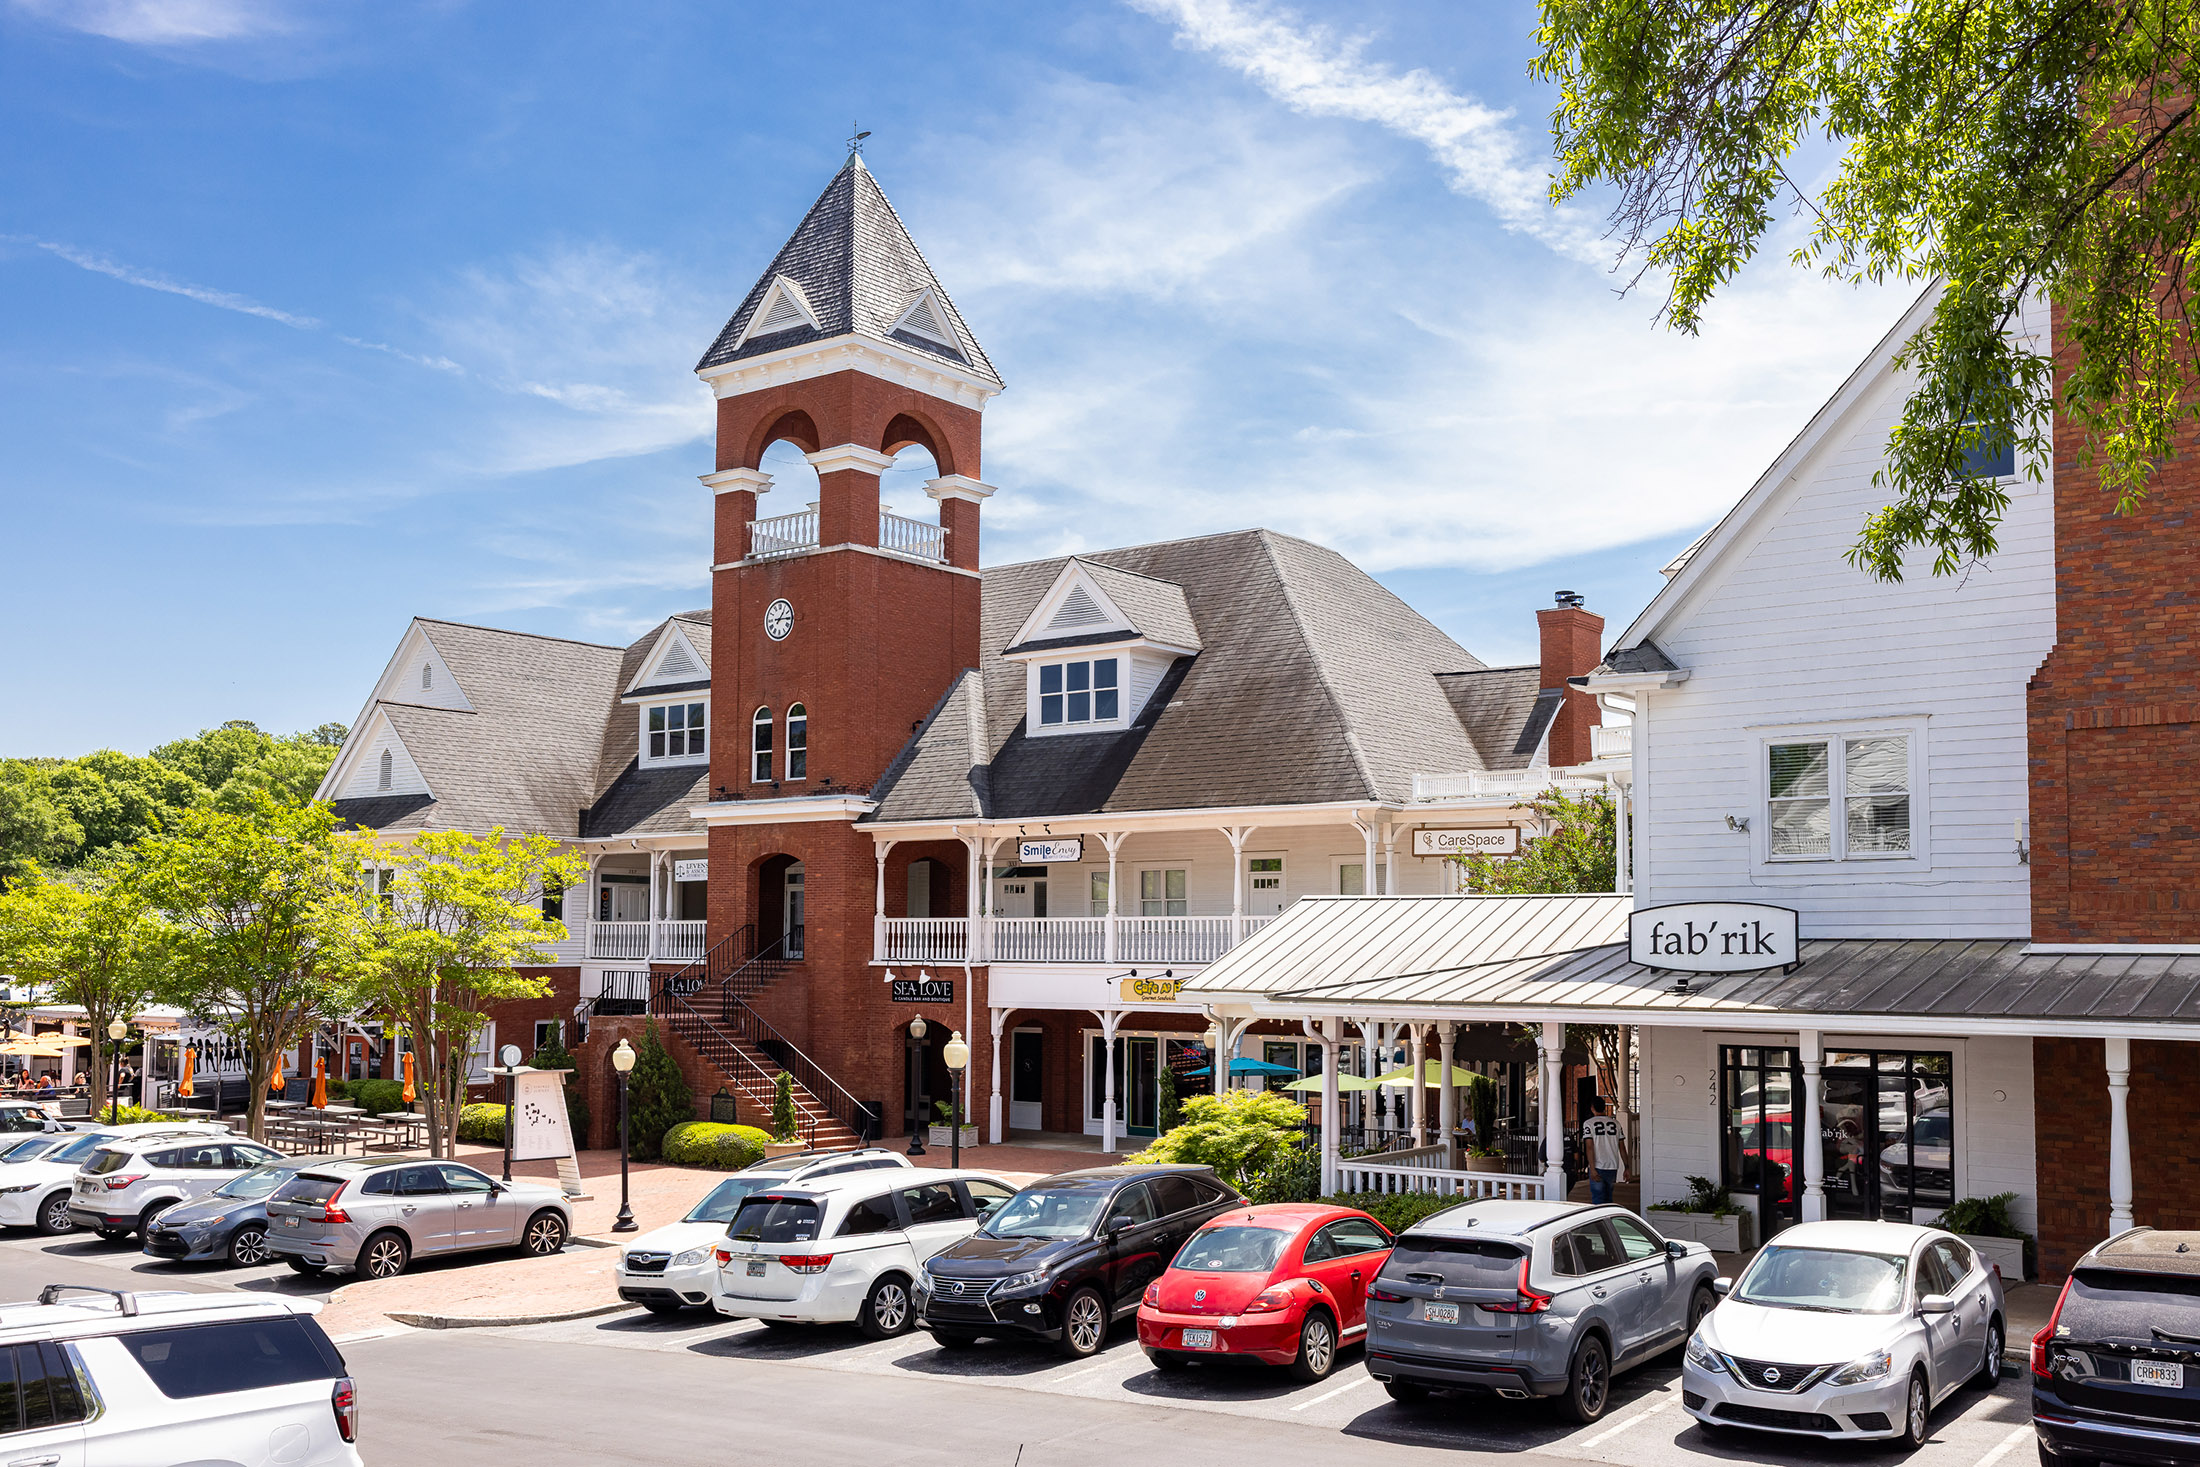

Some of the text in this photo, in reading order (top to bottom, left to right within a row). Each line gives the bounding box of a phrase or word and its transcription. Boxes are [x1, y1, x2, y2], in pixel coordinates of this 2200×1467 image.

[1438, 833, 1505, 848] CareSpace
[1023, 842, 1077, 859] Smile Envy
[1649, 920, 1777, 955] fab'rik
[894, 981, 951, 997] SEA LOVE
[1133, 980, 1159, 996] Cafe
[1709, 1068, 1717, 1106] 242
[1593, 1121, 1617, 1136] 23
[2136, 1366, 2177, 1381] CRB1833
